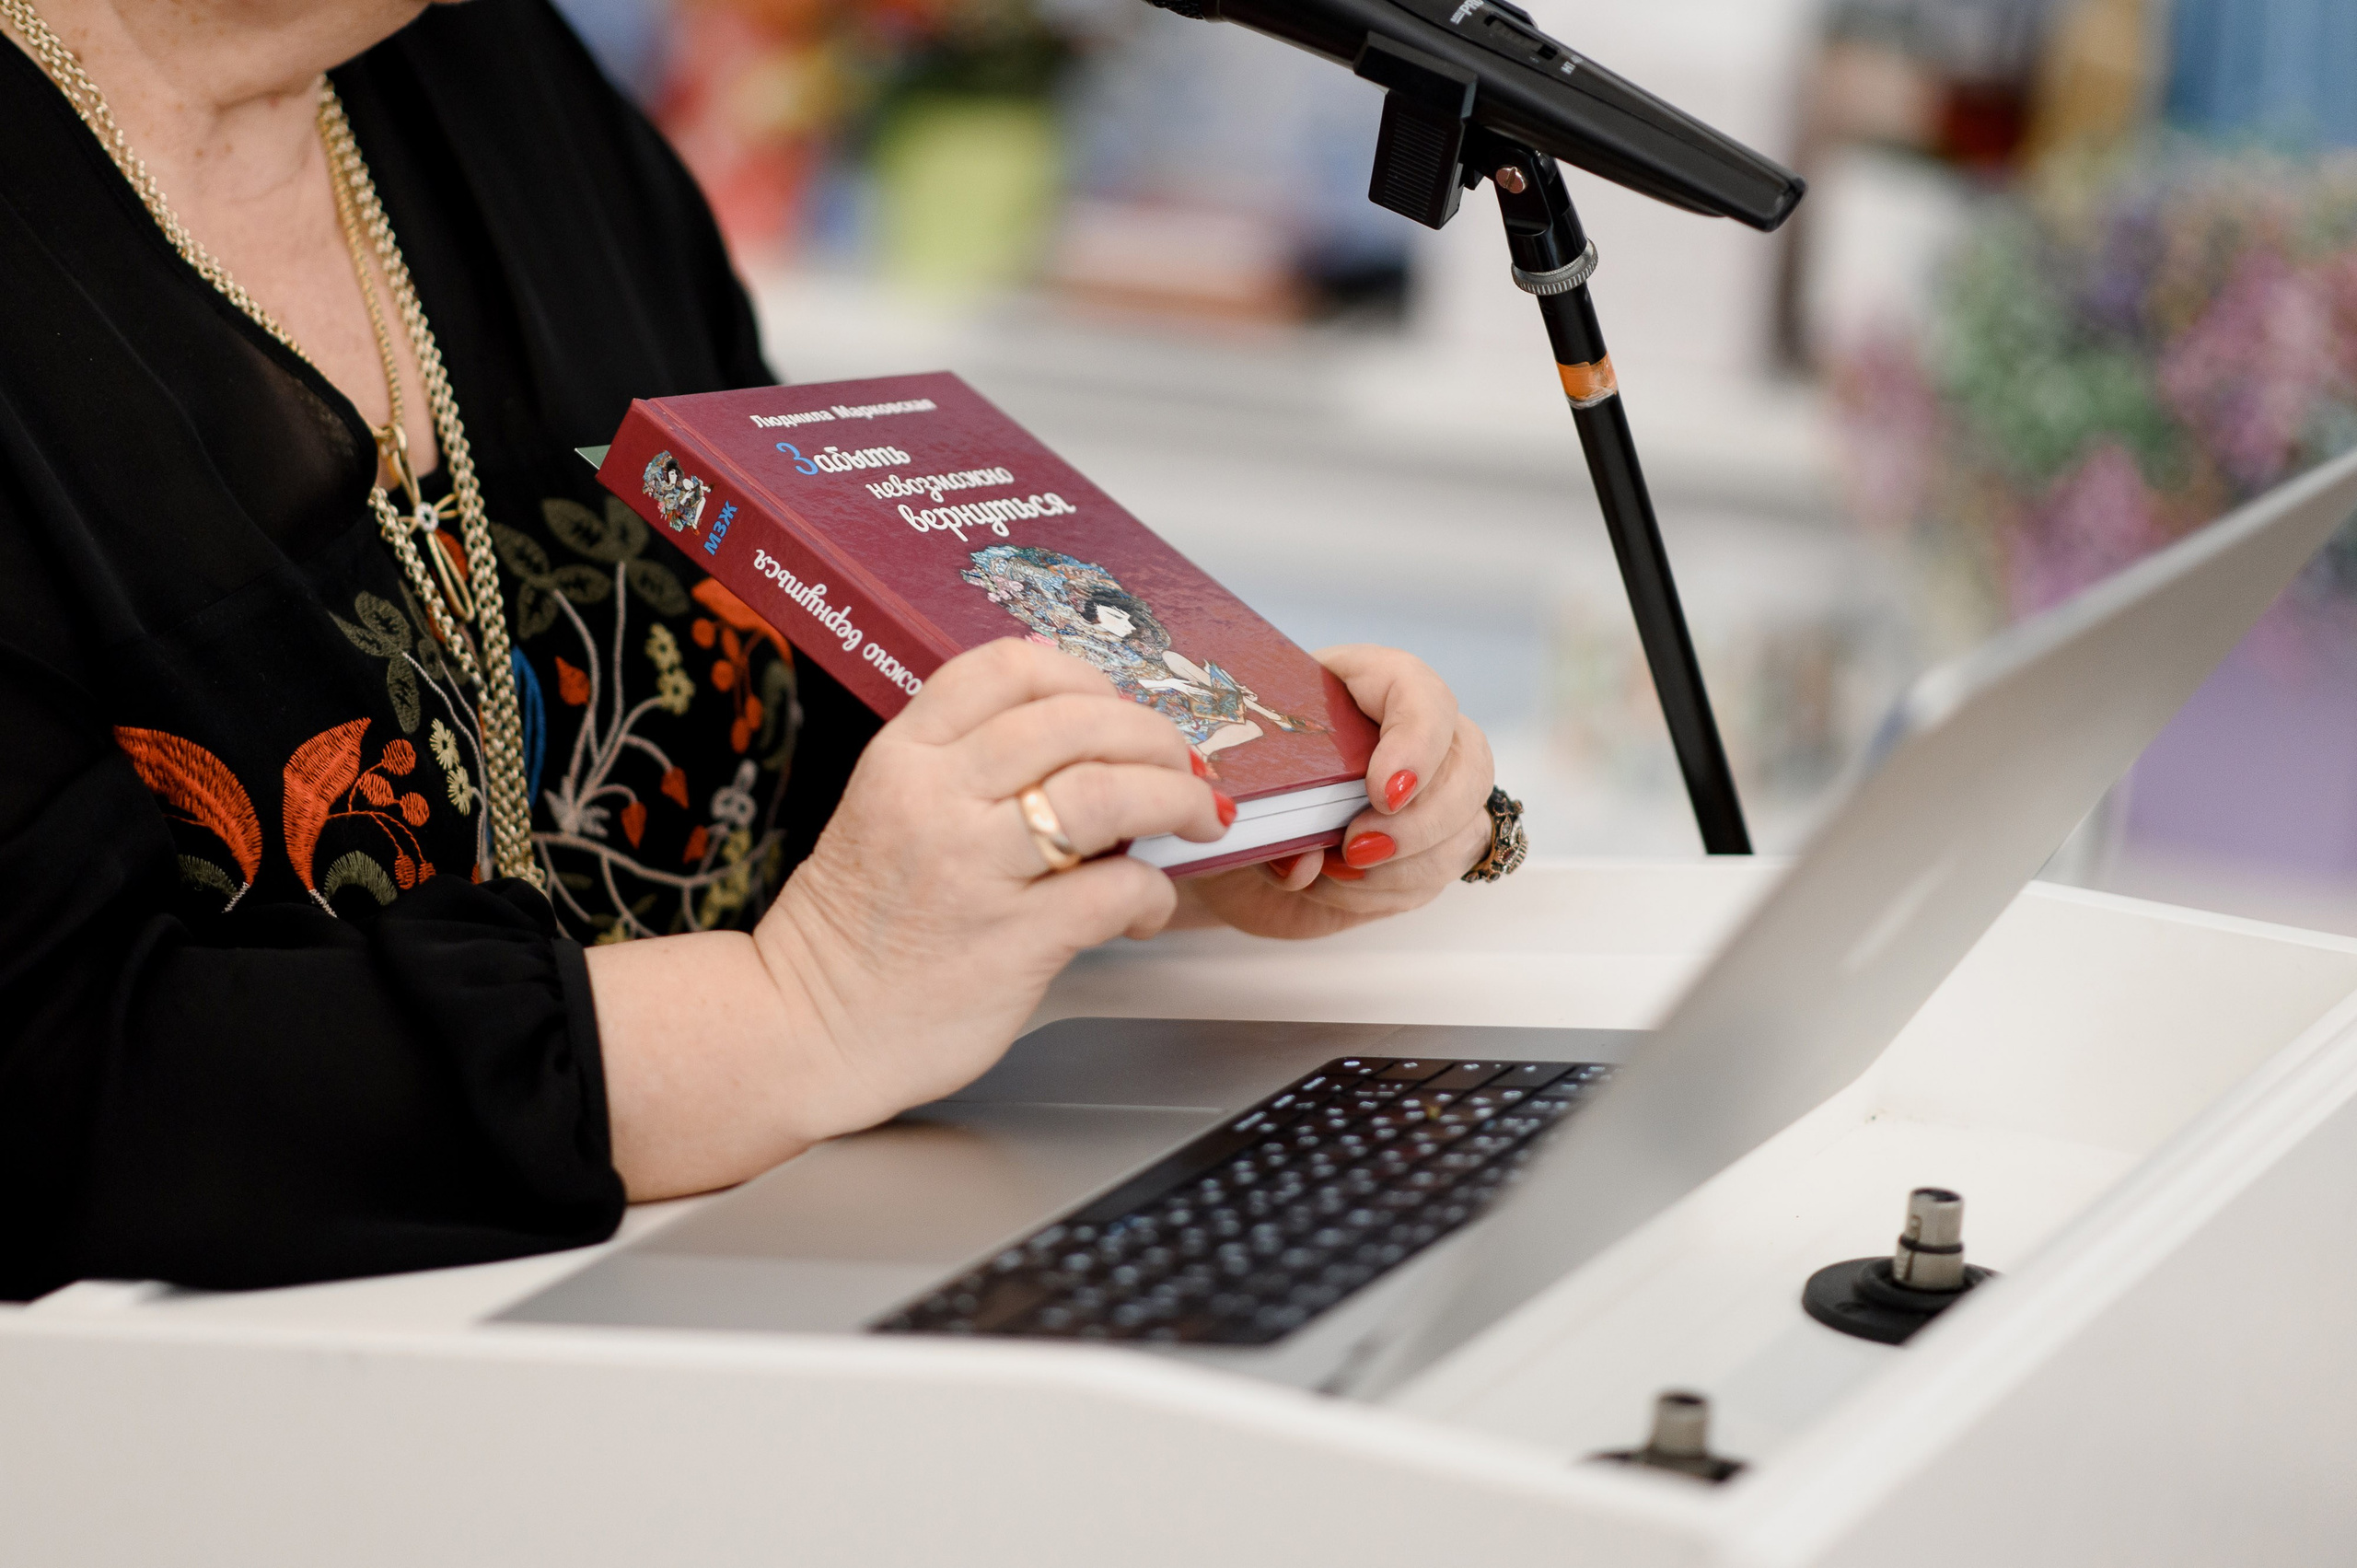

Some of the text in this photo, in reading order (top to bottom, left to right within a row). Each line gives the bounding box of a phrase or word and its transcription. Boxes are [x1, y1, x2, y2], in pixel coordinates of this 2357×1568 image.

[749, 398, 937, 428] Людмила Марковская
[775, 442, 911, 475] Забыть
[865, 466, 1015, 503] невозможно
[898, 492, 1076, 542] вернуться
[753, 549, 923, 696] ожно вернуться
